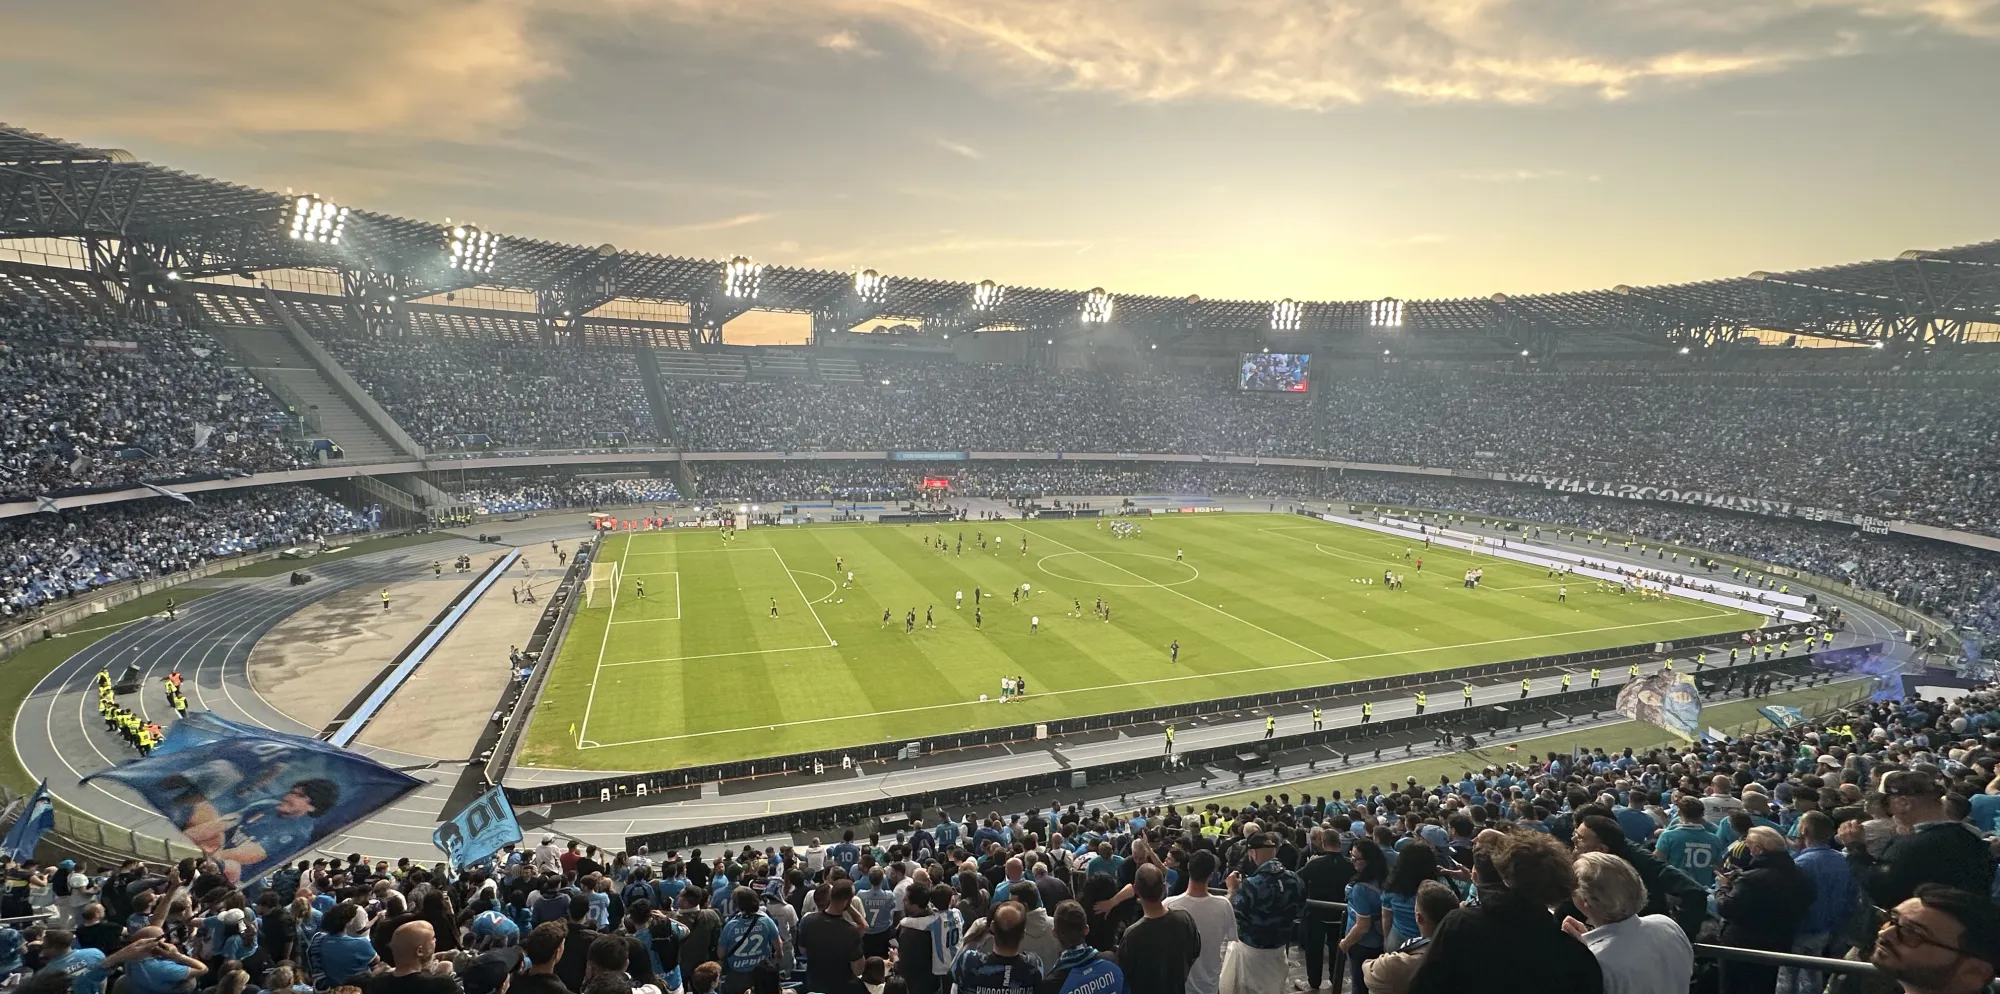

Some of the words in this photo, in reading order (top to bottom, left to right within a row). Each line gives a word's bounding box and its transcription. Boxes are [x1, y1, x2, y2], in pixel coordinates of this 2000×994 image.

[944, 829, 952, 840] 11
[840, 851, 853, 862] 10
[1684, 847, 1712, 868] 10
[869, 908, 880, 927] 7
[740, 924, 763, 934] LONZO
[946, 928, 959, 948] 10
[733, 933, 764, 957] 22
[1068, 971, 1115, 994] AMPIONI
